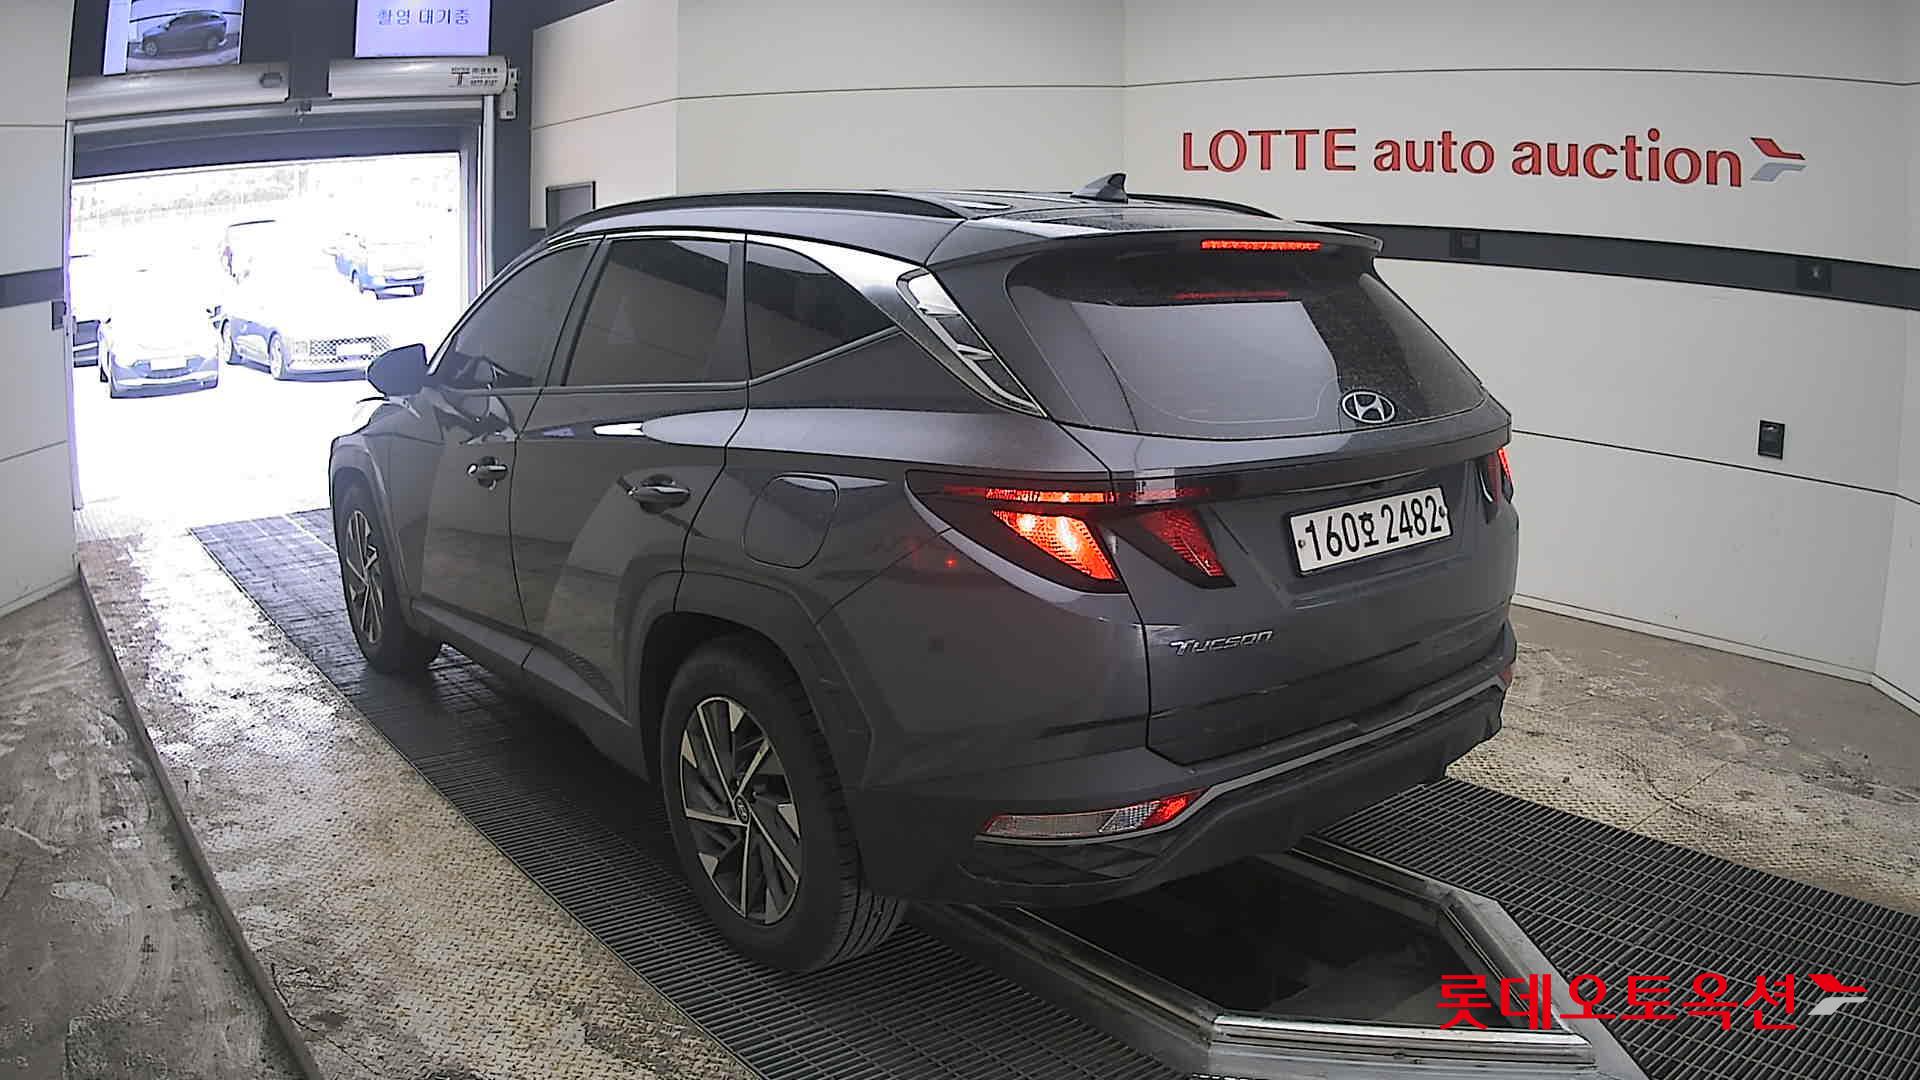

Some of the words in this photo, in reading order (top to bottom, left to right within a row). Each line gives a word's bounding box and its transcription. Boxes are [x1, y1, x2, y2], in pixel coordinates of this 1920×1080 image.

[419, 8, 470, 25] 대기중
[1183, 128, 1357, 172] LOTTE
[1373, 130, 1495, 174] auto
[1511, 127, 1743, 188] auction
